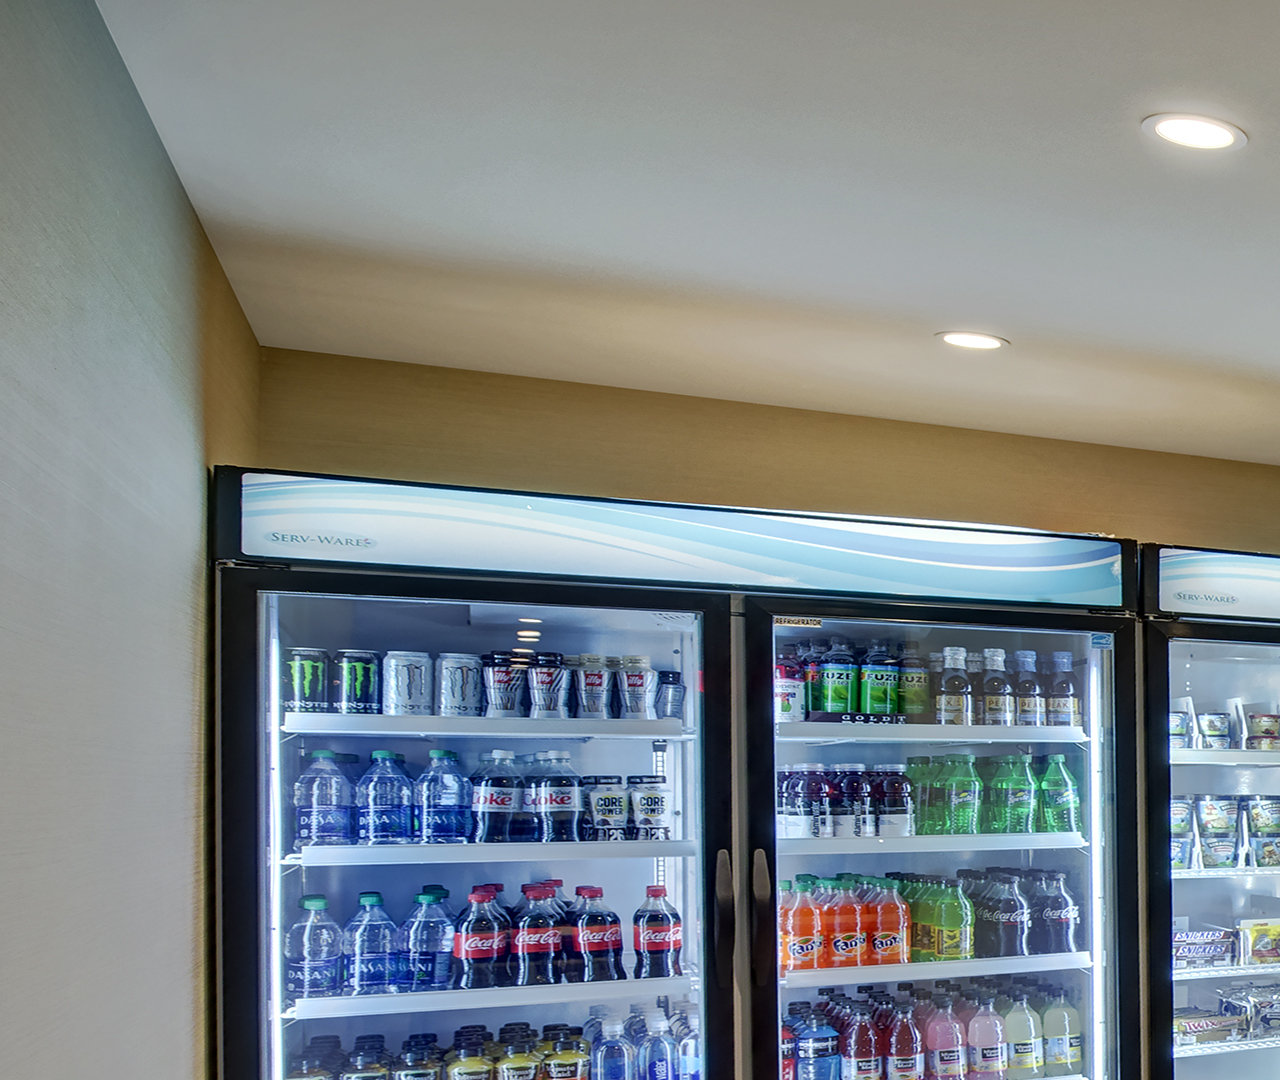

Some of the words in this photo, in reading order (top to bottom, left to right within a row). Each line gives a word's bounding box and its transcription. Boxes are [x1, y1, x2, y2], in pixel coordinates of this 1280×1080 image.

[271, 532, 366, 548] SERV-WARE
[596, 797, 623, 808] CORE
[639, 797, 666, 808] CORE
